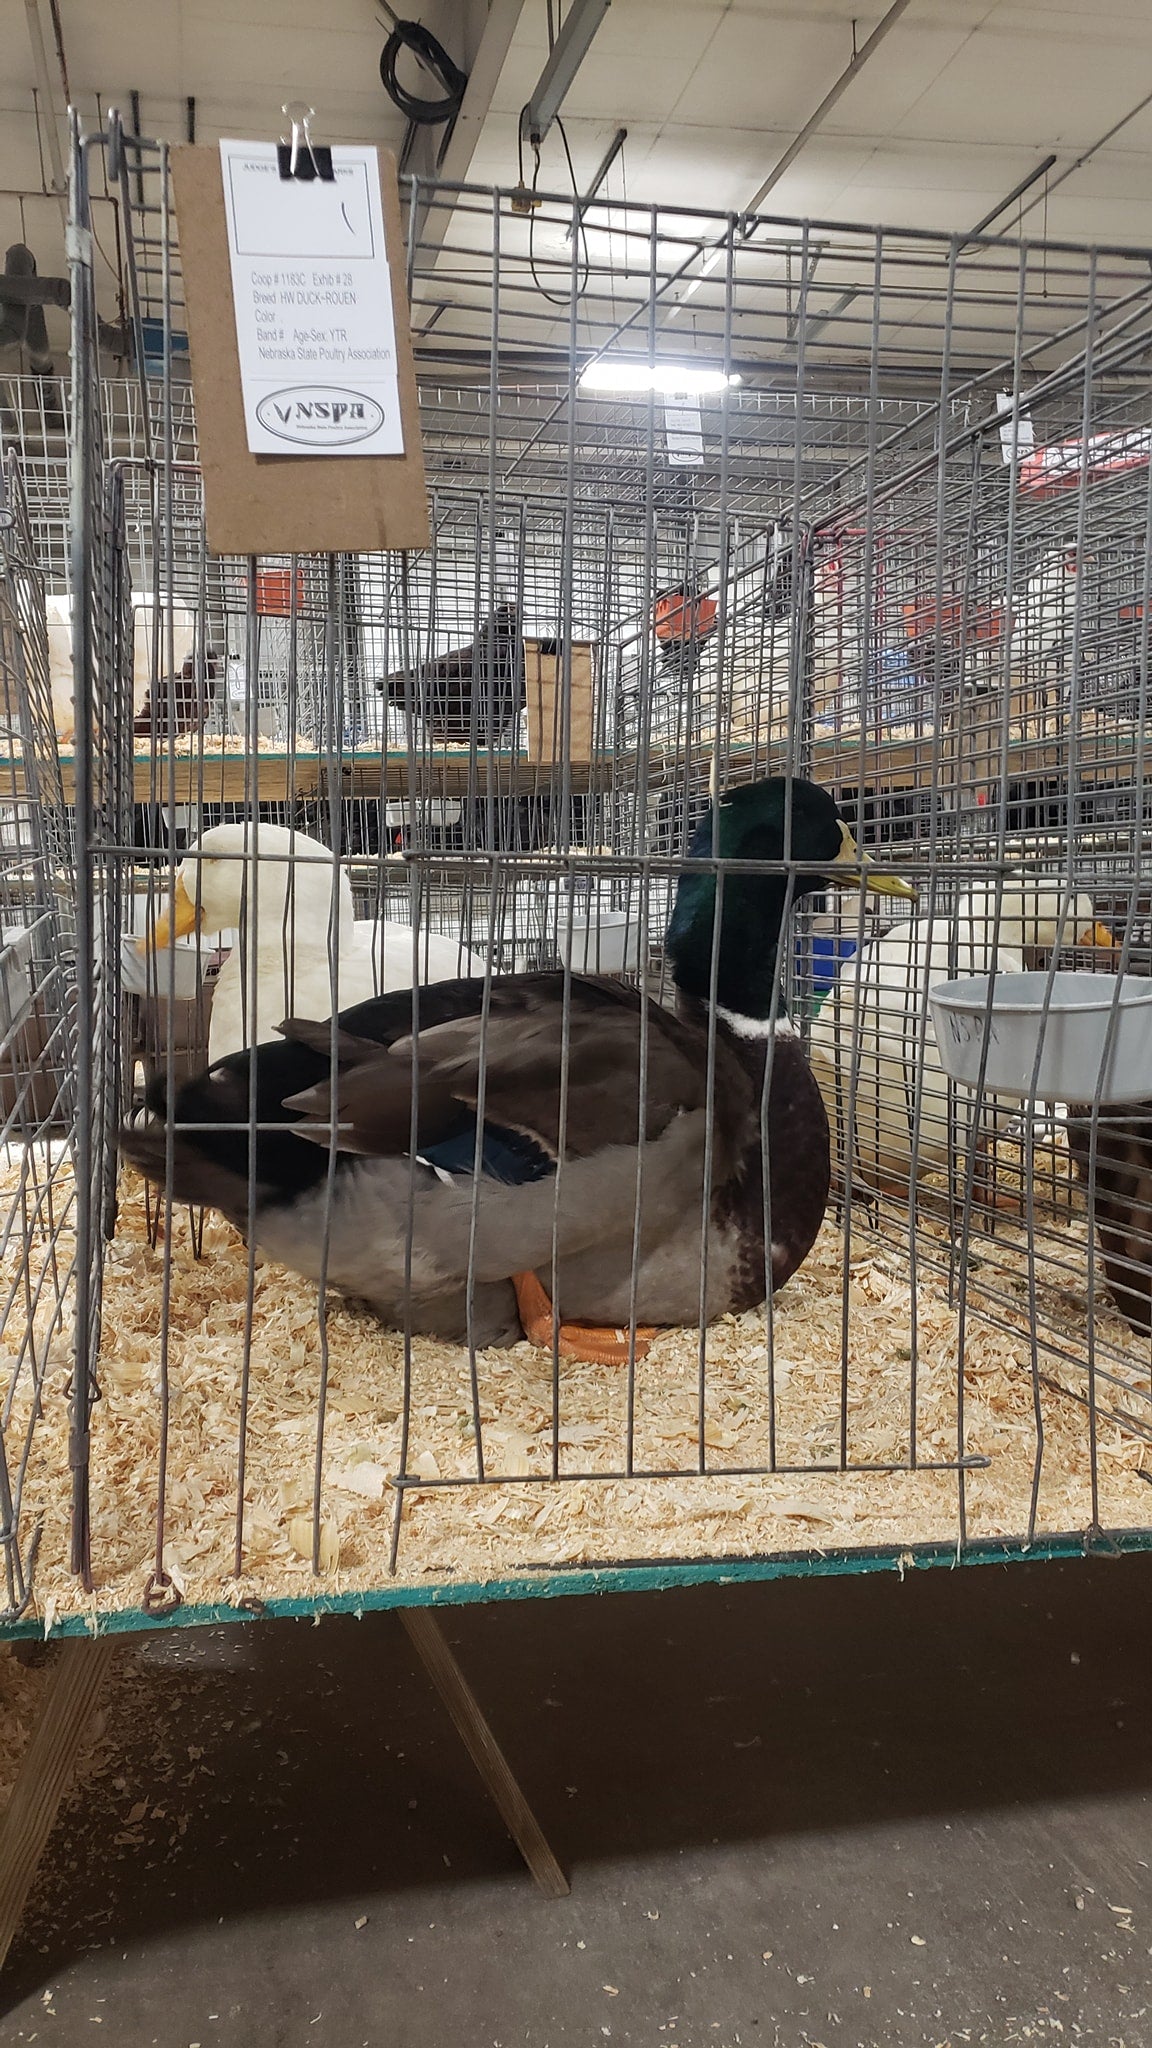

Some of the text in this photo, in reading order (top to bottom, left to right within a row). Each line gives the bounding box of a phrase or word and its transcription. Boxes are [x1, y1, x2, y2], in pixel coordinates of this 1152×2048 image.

[251, 271, 272, 287] Coop
[273, 273, 279, 284] #
[281, 272, 306, 287] 1183C
[312, 272, 334, 287] Exhib
[343, 273, 353, 287] 28
[253, 290, 357, 305] Breed HW DUCK-ROUEN
[255, 309, 276, 322] Color
[256, 328, 277, 341] Band
[277, 329, 284, 339] #
[329, 328, 348, 342] YTR
[258, 346, 391, 363] Nebraska State Poultry Association
[296, 402, 365, 424] NSPA
